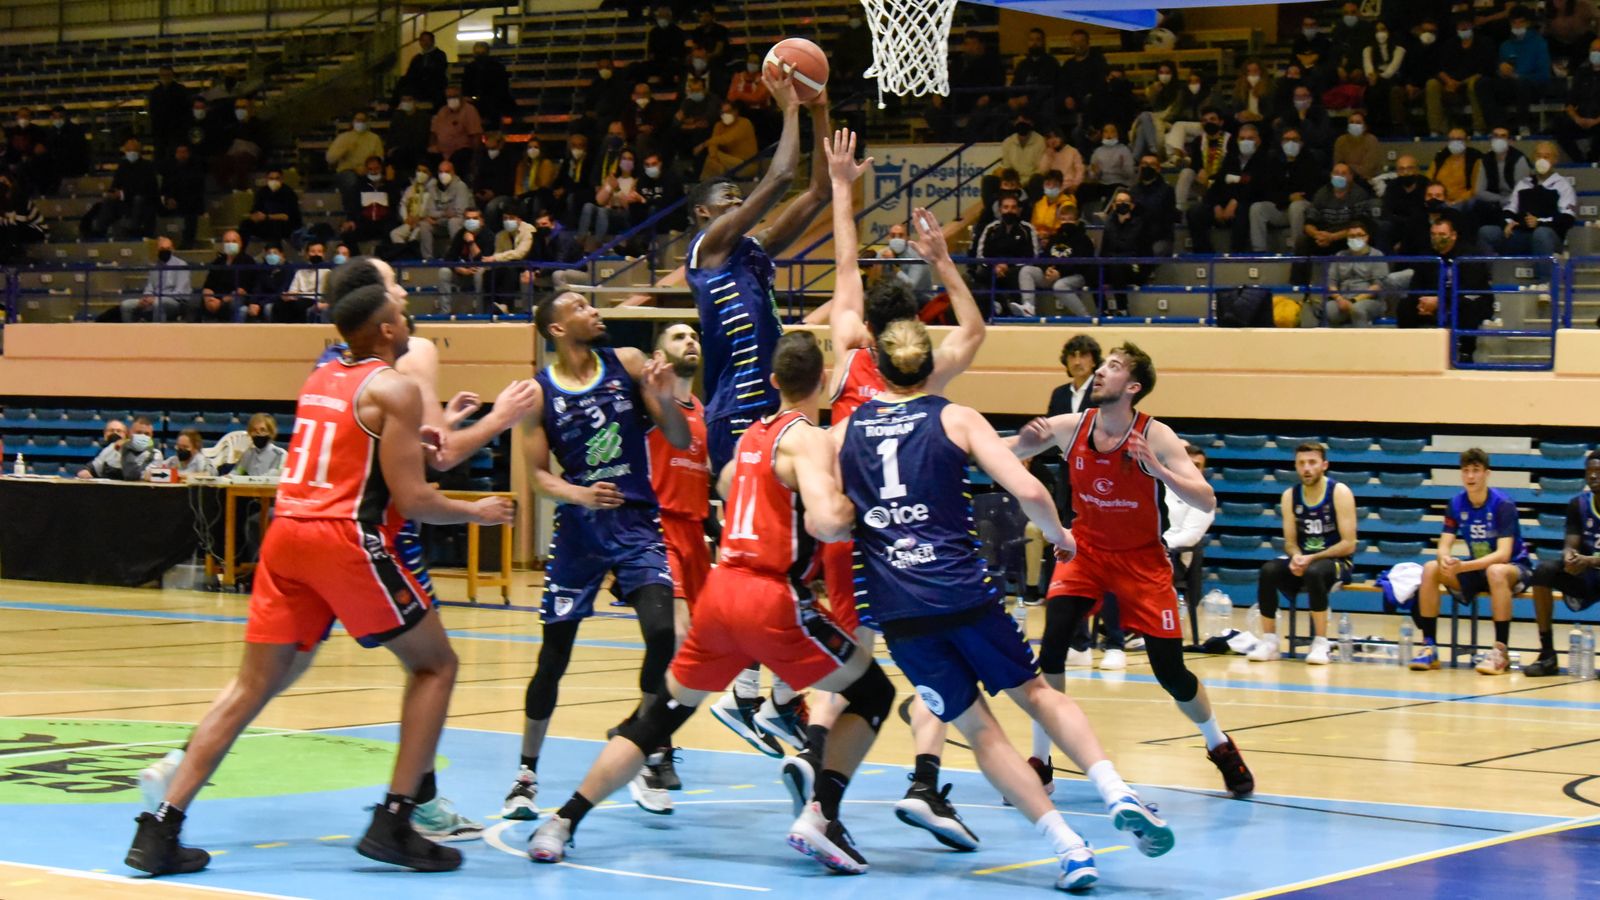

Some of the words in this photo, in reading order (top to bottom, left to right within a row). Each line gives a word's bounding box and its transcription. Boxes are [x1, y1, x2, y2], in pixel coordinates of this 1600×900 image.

[585, 405, 607, 429] 3
[865, 422, 915, 437] ROWAN
[279, 417, 337, 489] 31
[877, 438, 907, 499] 1
[728, 475, 759, 540] 11
[889, 502, 929, 524] ice
[1304, 519, 1322, 534] 30
[1470, 524, 1487, 538] 55
[1161, 609, 1175, 631] 8
